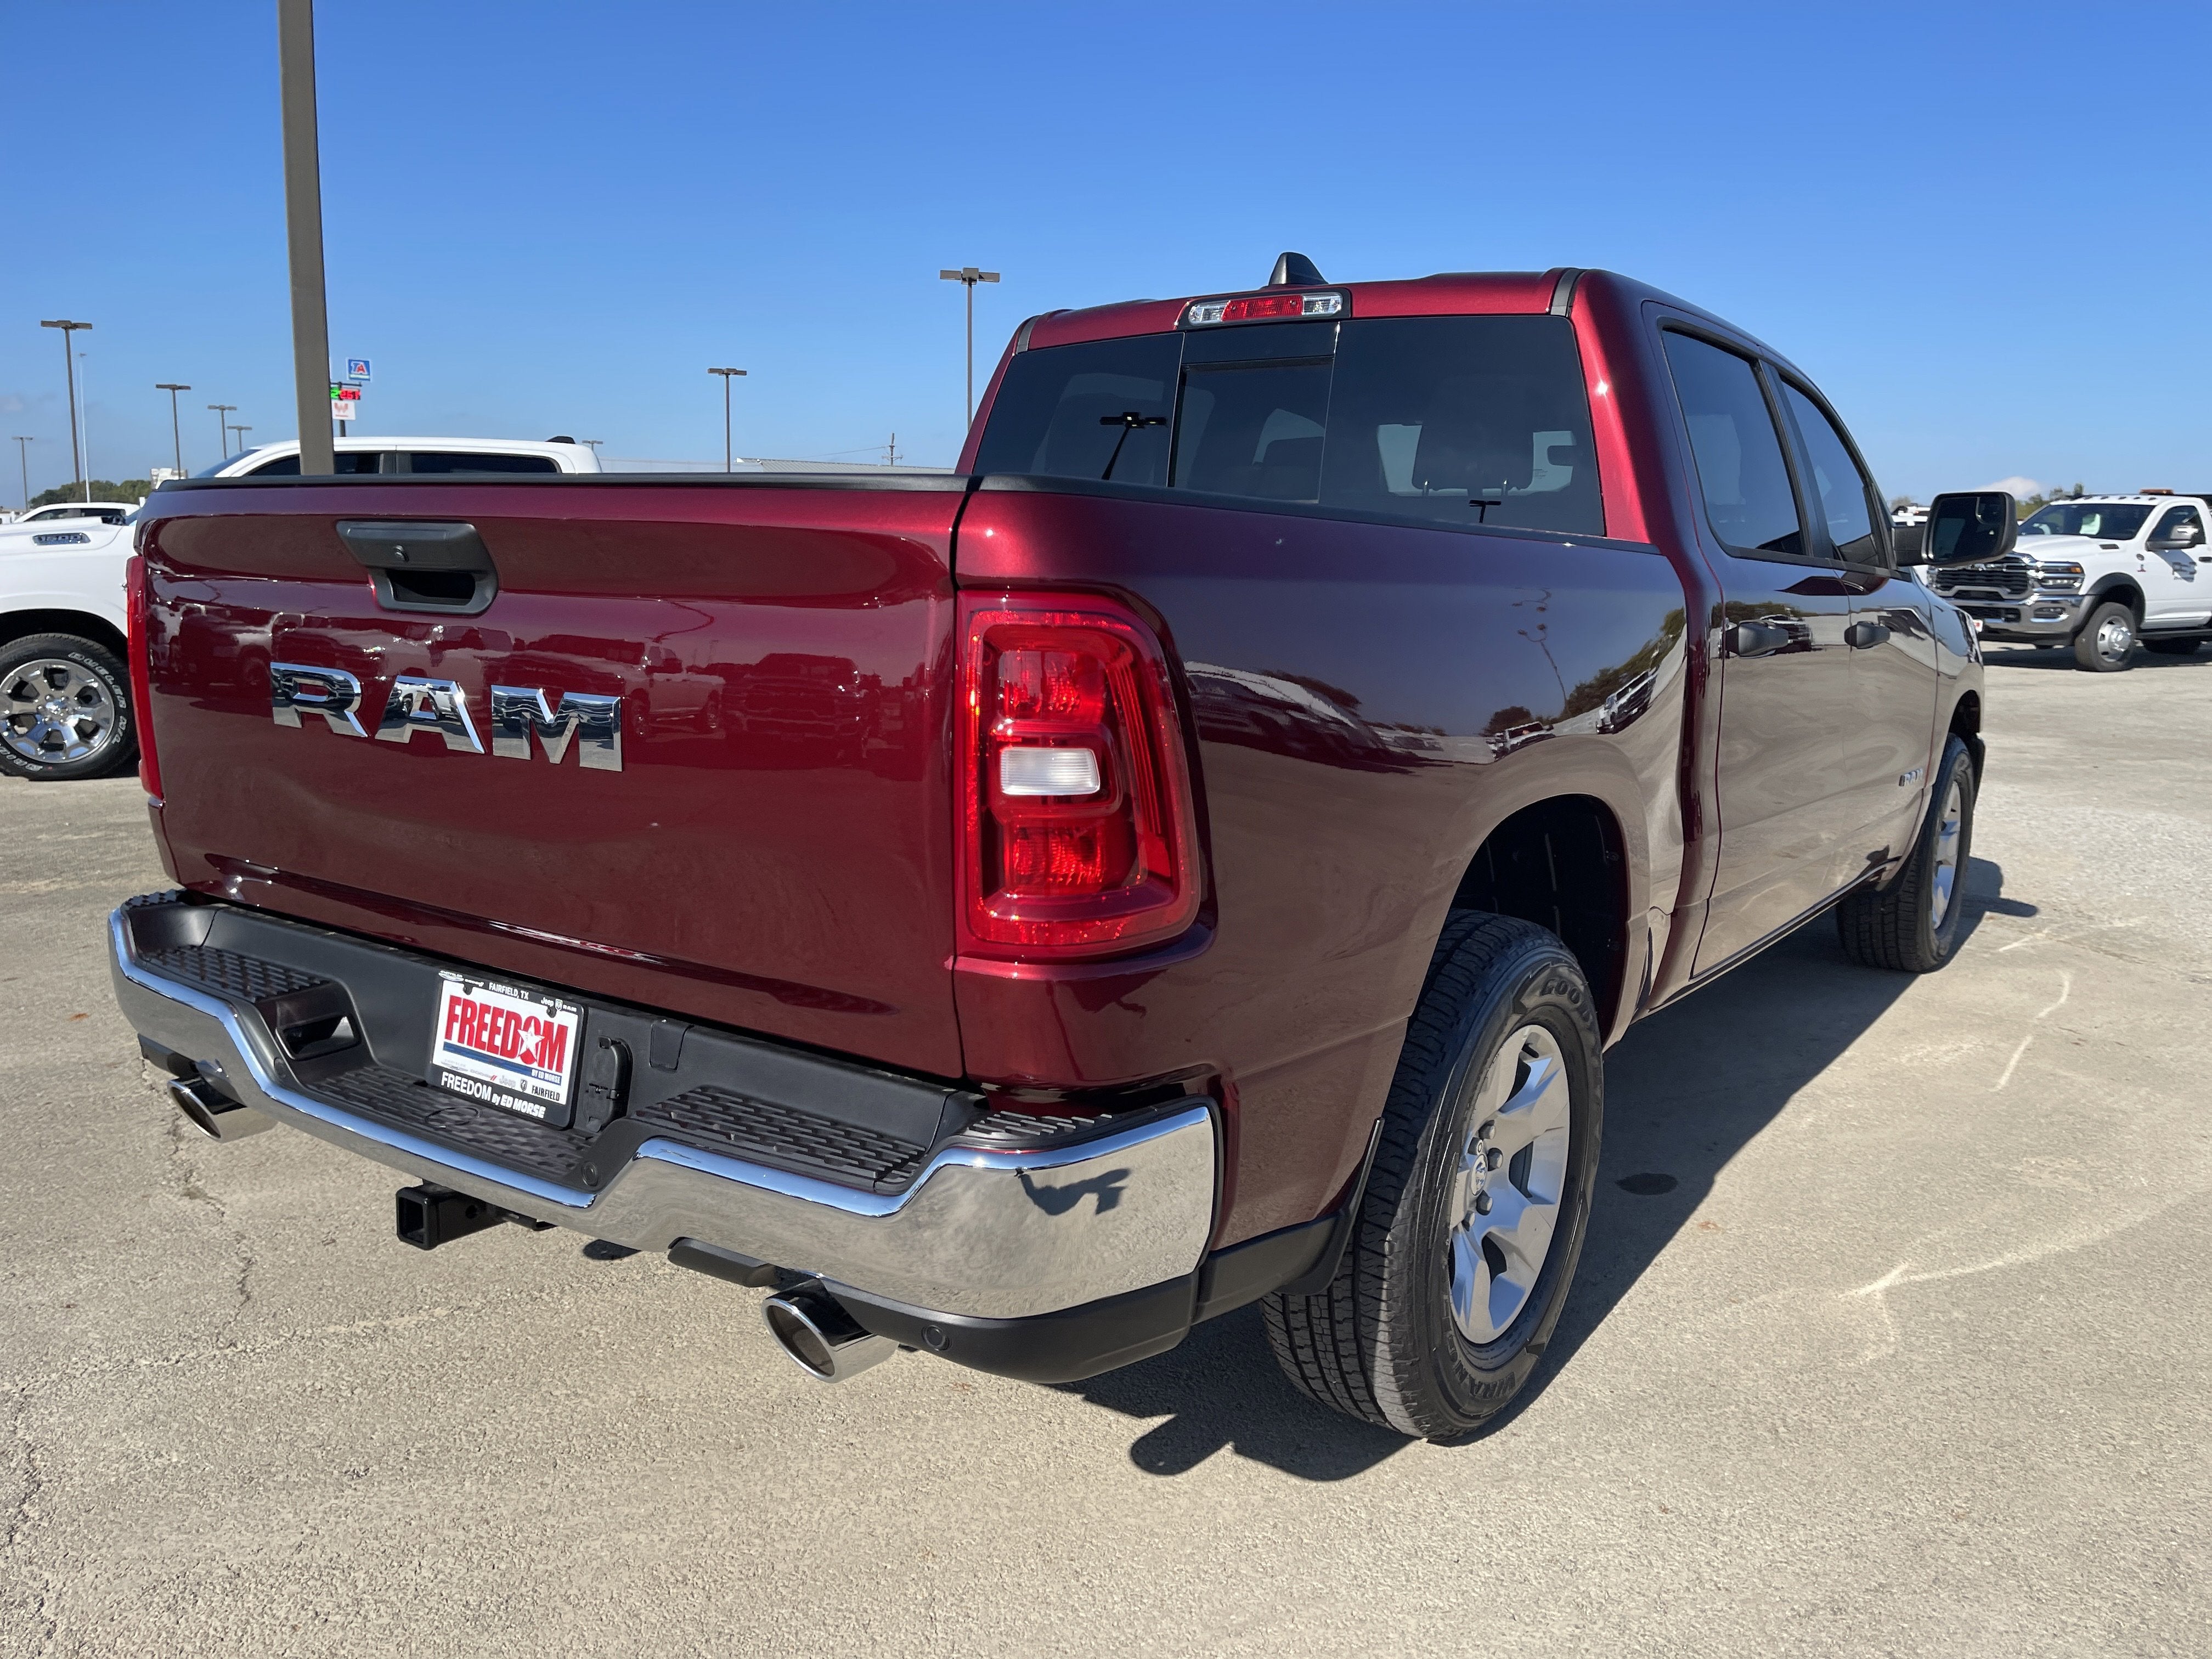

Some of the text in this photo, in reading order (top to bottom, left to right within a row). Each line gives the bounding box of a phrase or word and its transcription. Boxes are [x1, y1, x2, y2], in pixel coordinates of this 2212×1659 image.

[270, 662, 623, 772] RAM
[488, 981, 529, 1000] FAIRFIELD, TX
[540, 997, 554, 1007] Jeep
[444, 995, 569, 1074] FREEDOM
[531, 1069, 538, 1077] BY
[544, 1072, 561, 1084] MORSE
[441, 1071, 492, 1102] FREEDOM
[500, 1094, 514, 1109] ED
[512, 1098, 546, 1119] MORSE
[531, 1085, 561, 1102] FAIRFIELD
